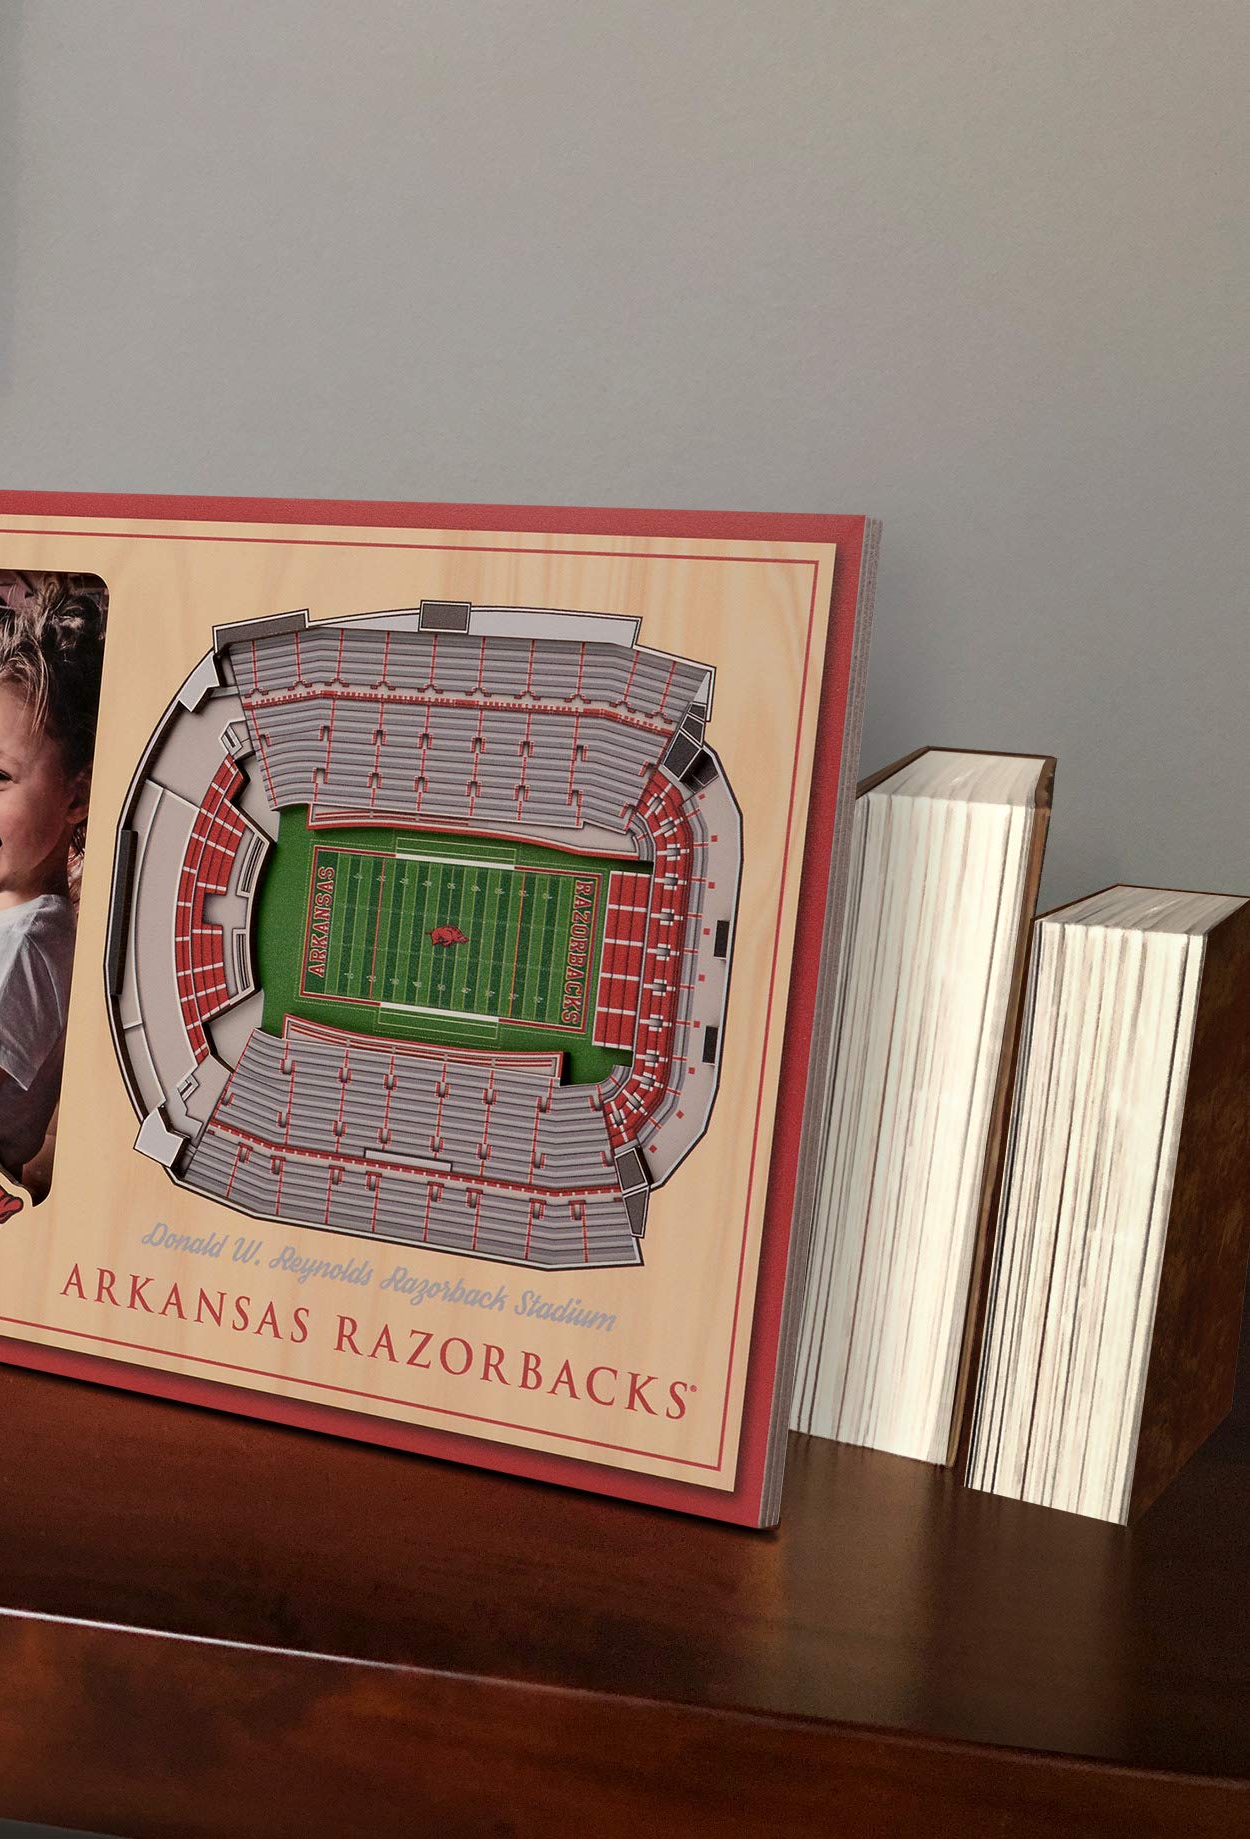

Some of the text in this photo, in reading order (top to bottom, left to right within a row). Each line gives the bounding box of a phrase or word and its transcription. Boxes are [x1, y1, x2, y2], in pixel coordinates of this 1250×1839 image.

[307, 866, 335, 978] ARKANSAS
[561, 879, 594, 1025] RAZORBACKS
[60, 1262, 689, 1420] ARKANSAS RAZORBACKS
[141, 1222, 617, 1332] Donald W. Reynolds Razorback Stadium
